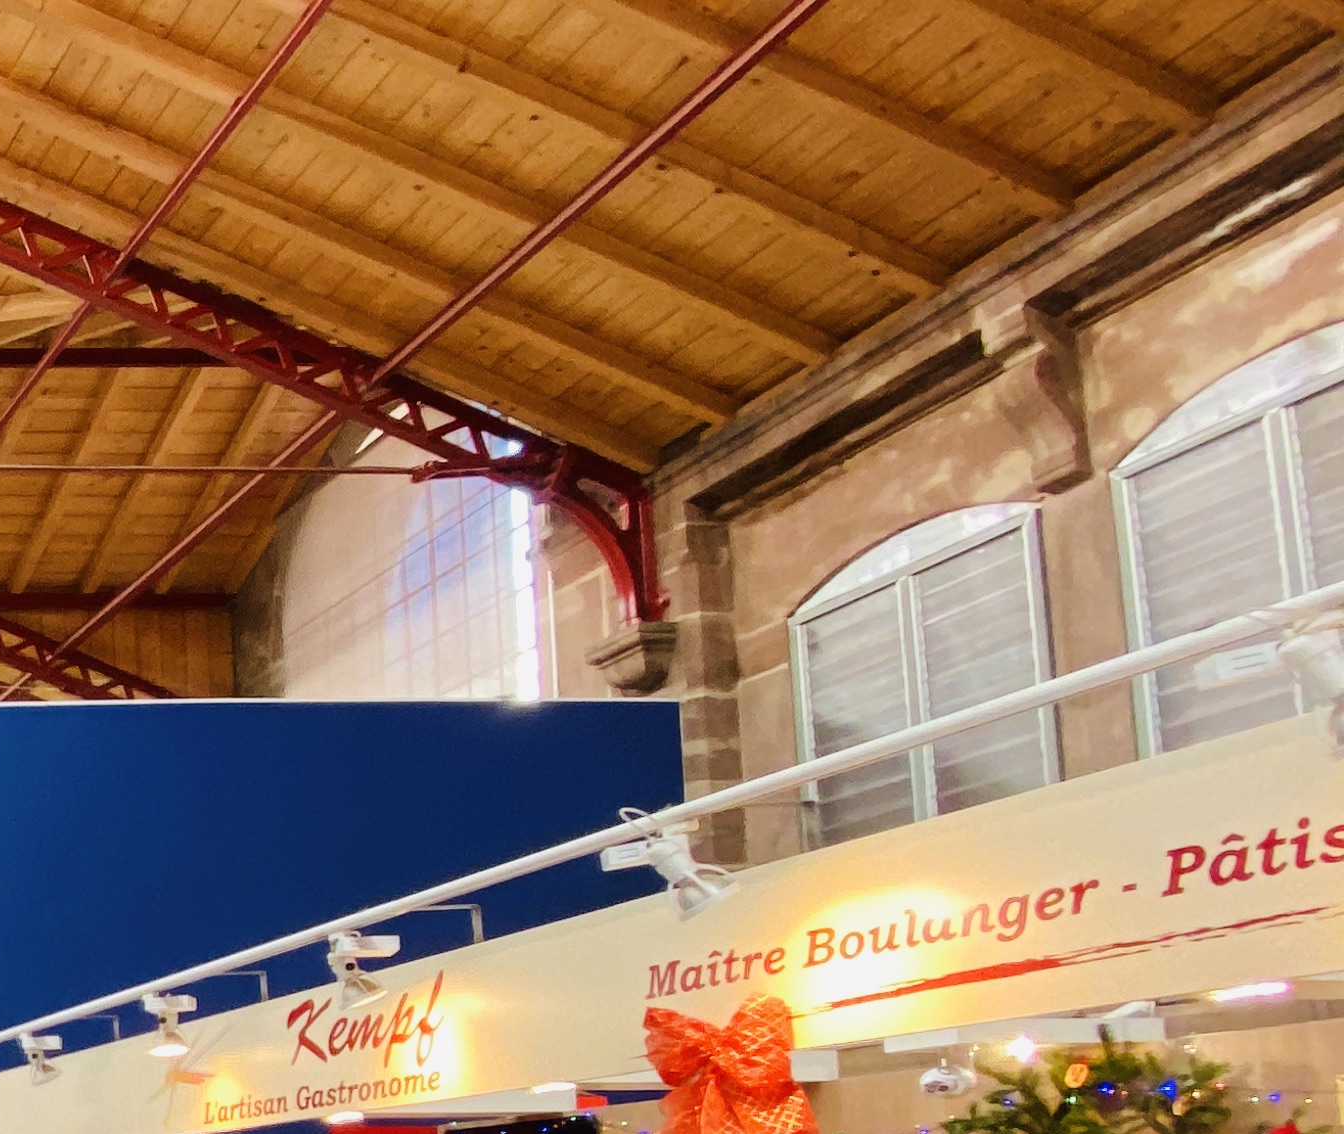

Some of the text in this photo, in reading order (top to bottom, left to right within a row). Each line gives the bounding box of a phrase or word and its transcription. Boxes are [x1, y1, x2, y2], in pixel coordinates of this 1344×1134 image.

[645, 949, 786, 1001] Maître
[802, 877, 1099, 971] Boulanger
[287, 969, 445, 1069] Kempf
[204, 1071, 441, 1125] L'artisan Gastronome
